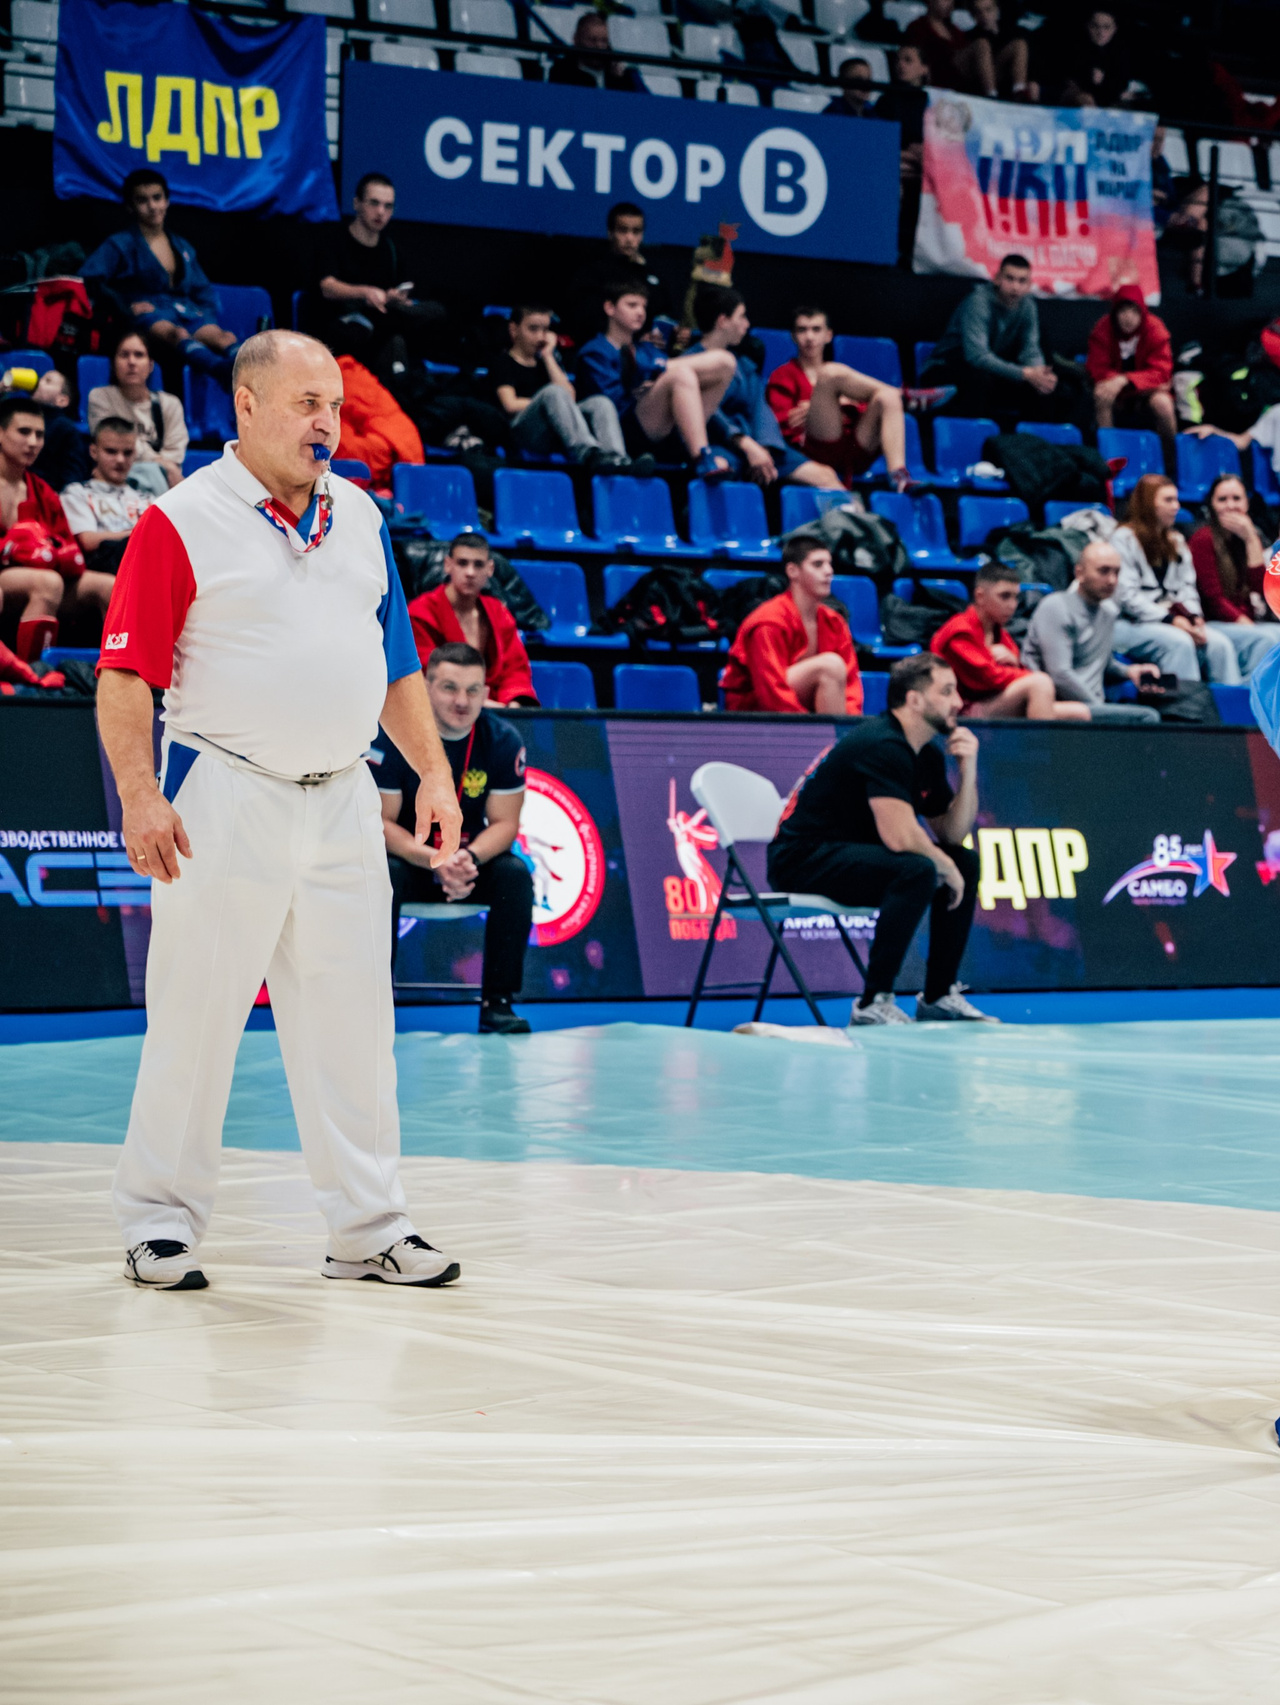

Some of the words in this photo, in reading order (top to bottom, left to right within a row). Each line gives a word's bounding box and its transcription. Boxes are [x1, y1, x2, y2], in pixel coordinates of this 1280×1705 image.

[97, 70, 280, 165] ЛДПР
[424, 116, 726, 202] СЕКТОР
[963, 828, 1089, 910] ДПР
[1127, 878, 1188, 898] САМБО
[1153, 834, 1182, 868] 85
